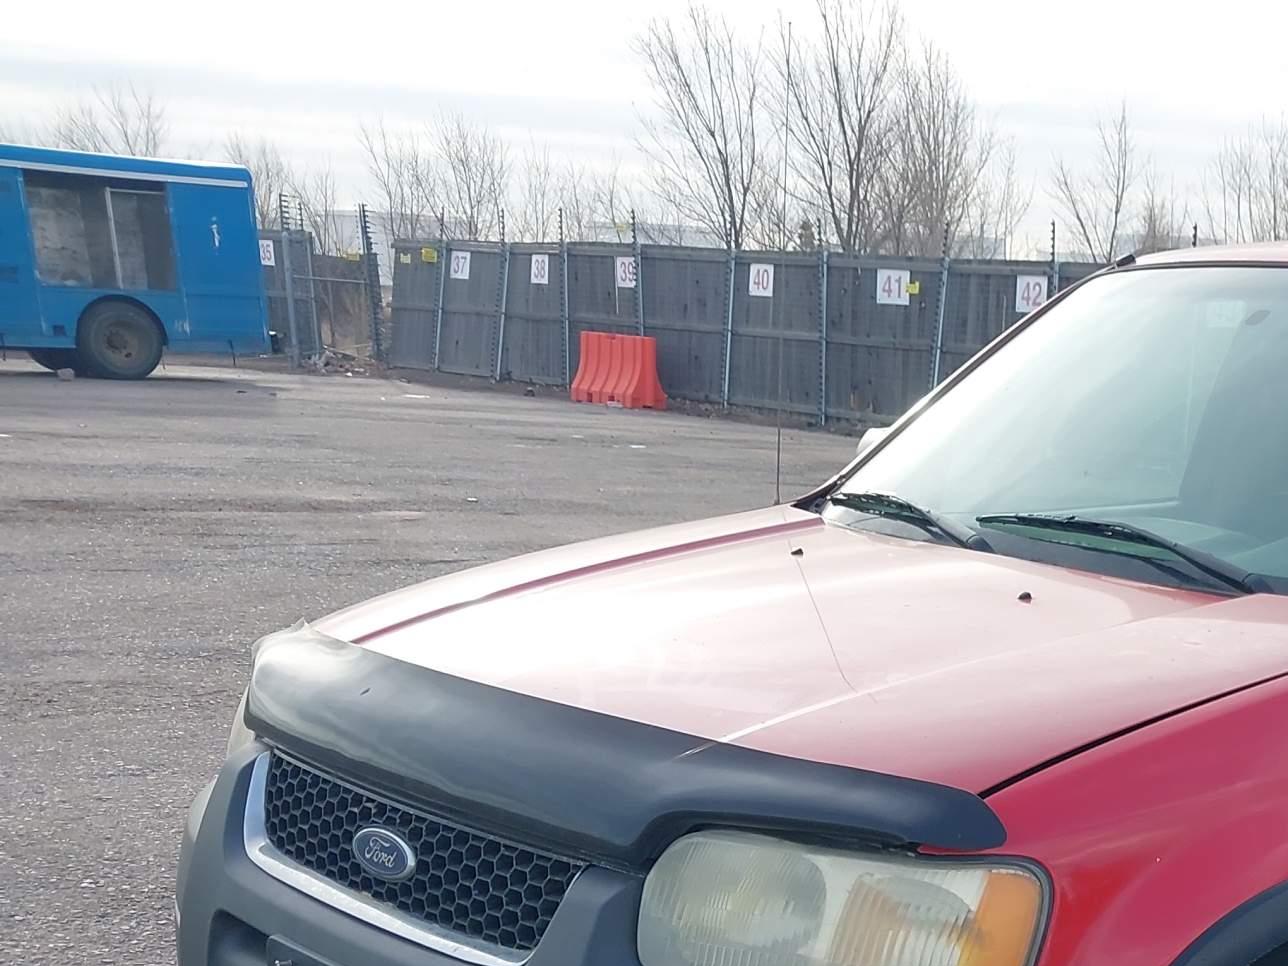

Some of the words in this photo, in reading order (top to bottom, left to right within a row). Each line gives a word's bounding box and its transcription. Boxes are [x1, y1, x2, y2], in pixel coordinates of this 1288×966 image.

[260, 243, 272, 261] 35
[453, 255, 467, 274] 37
[533, 259, 546, 279] 38
[620, 261, 634, 282] 39
[753, 268, 770, 290] 40
[882, 275, 902, 299] 41
[1021, 281, 1042, 306] 42
[364, 836, 397, 868] Ford
